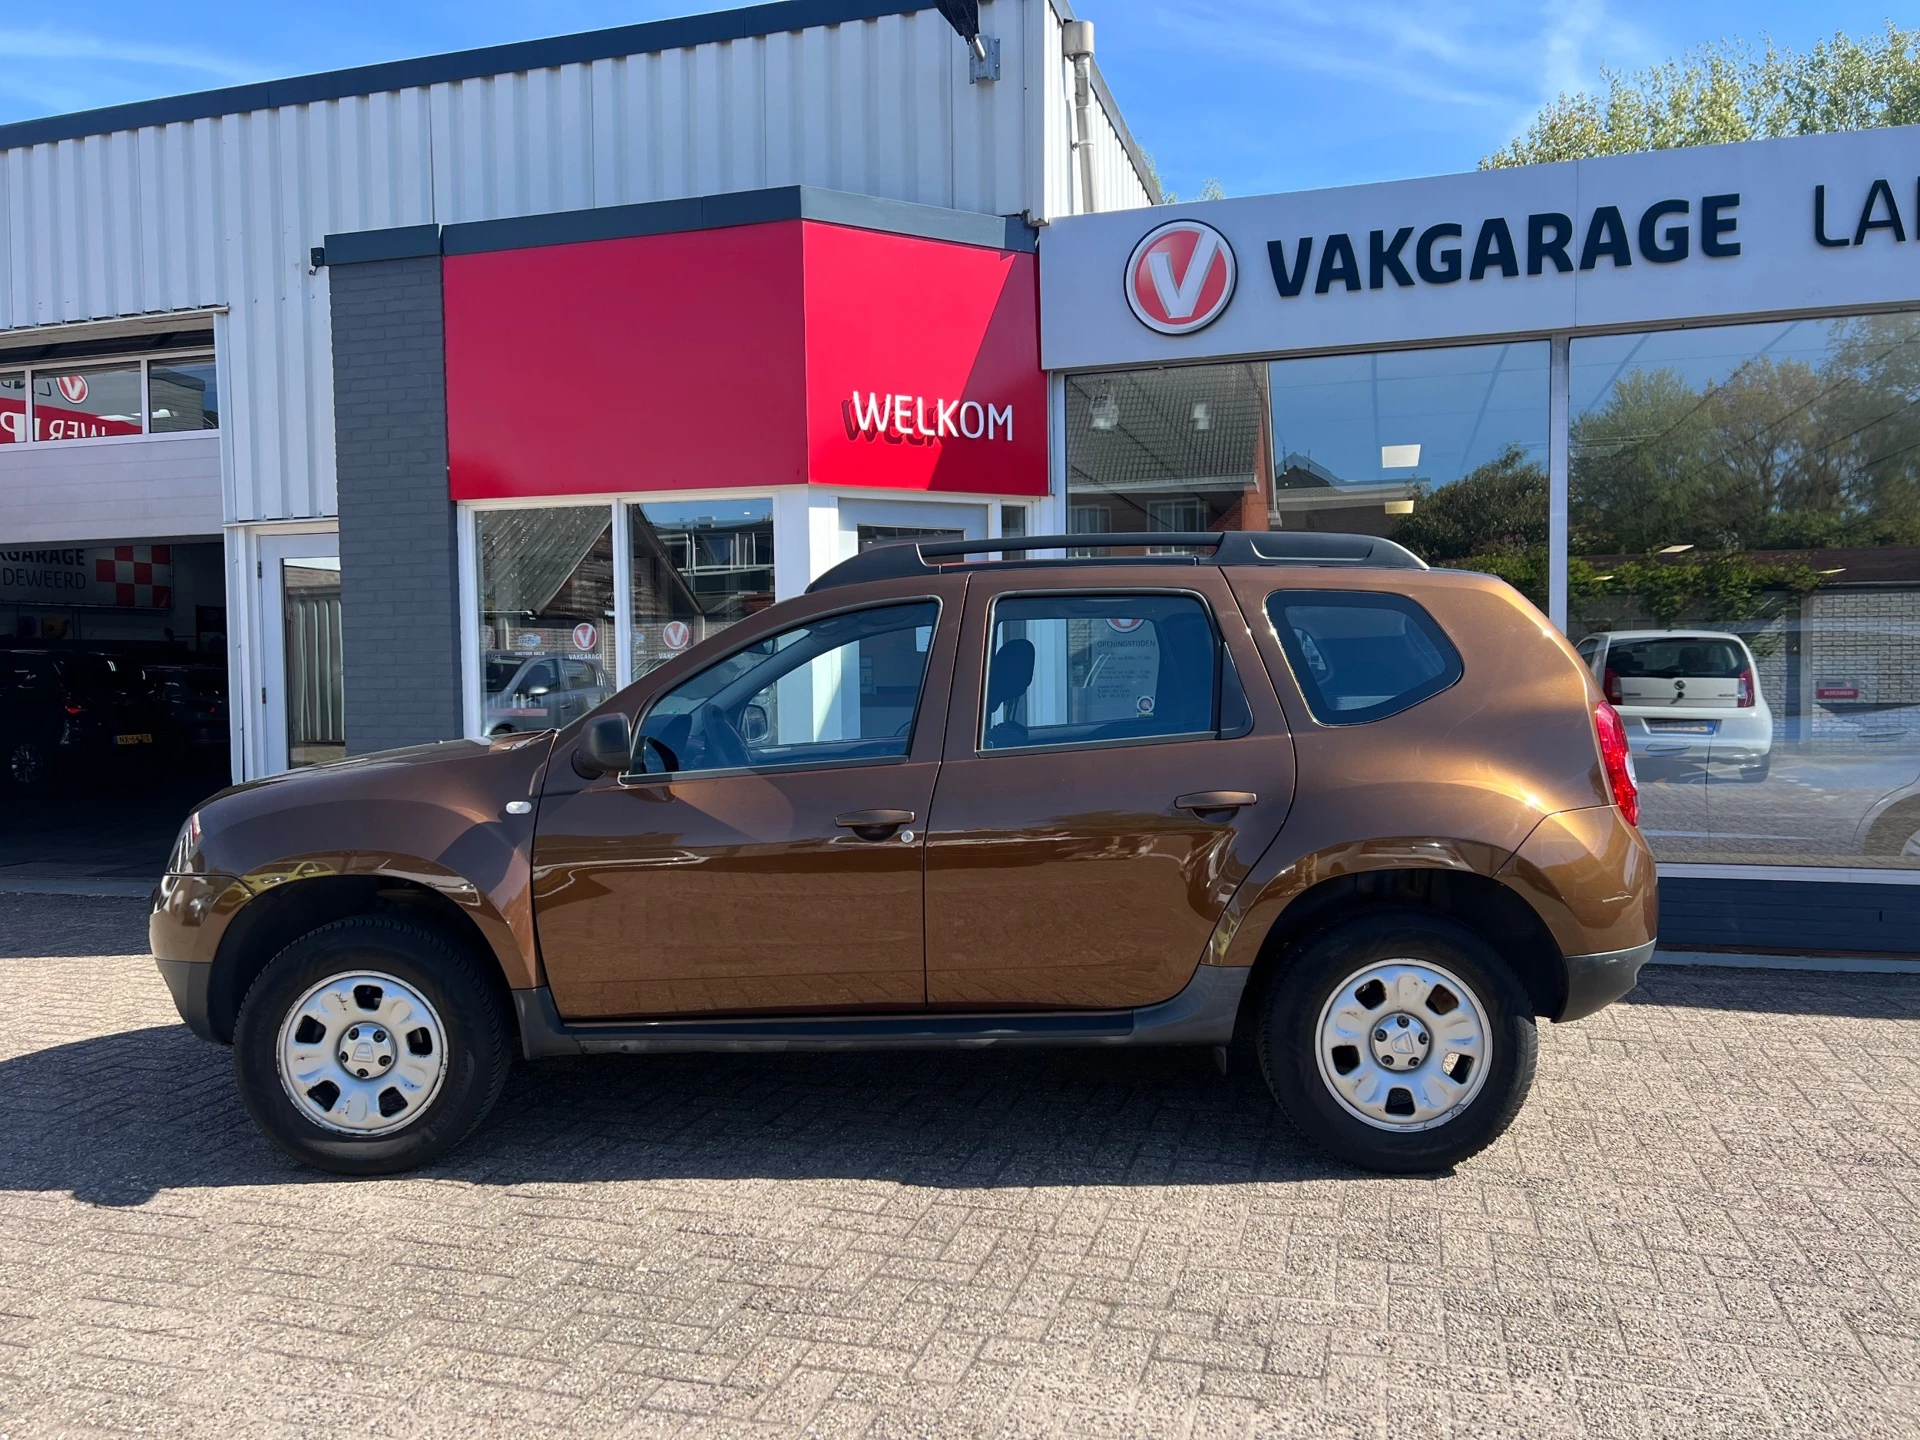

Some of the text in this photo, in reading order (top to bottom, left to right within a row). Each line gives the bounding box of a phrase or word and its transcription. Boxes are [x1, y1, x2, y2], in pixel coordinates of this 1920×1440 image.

[1267, 176, 1920, 298] VAKGARAGE LA
[852, 390, 1013, 442] WELKOM
[2, 567, 87, 590] DEWEERD
